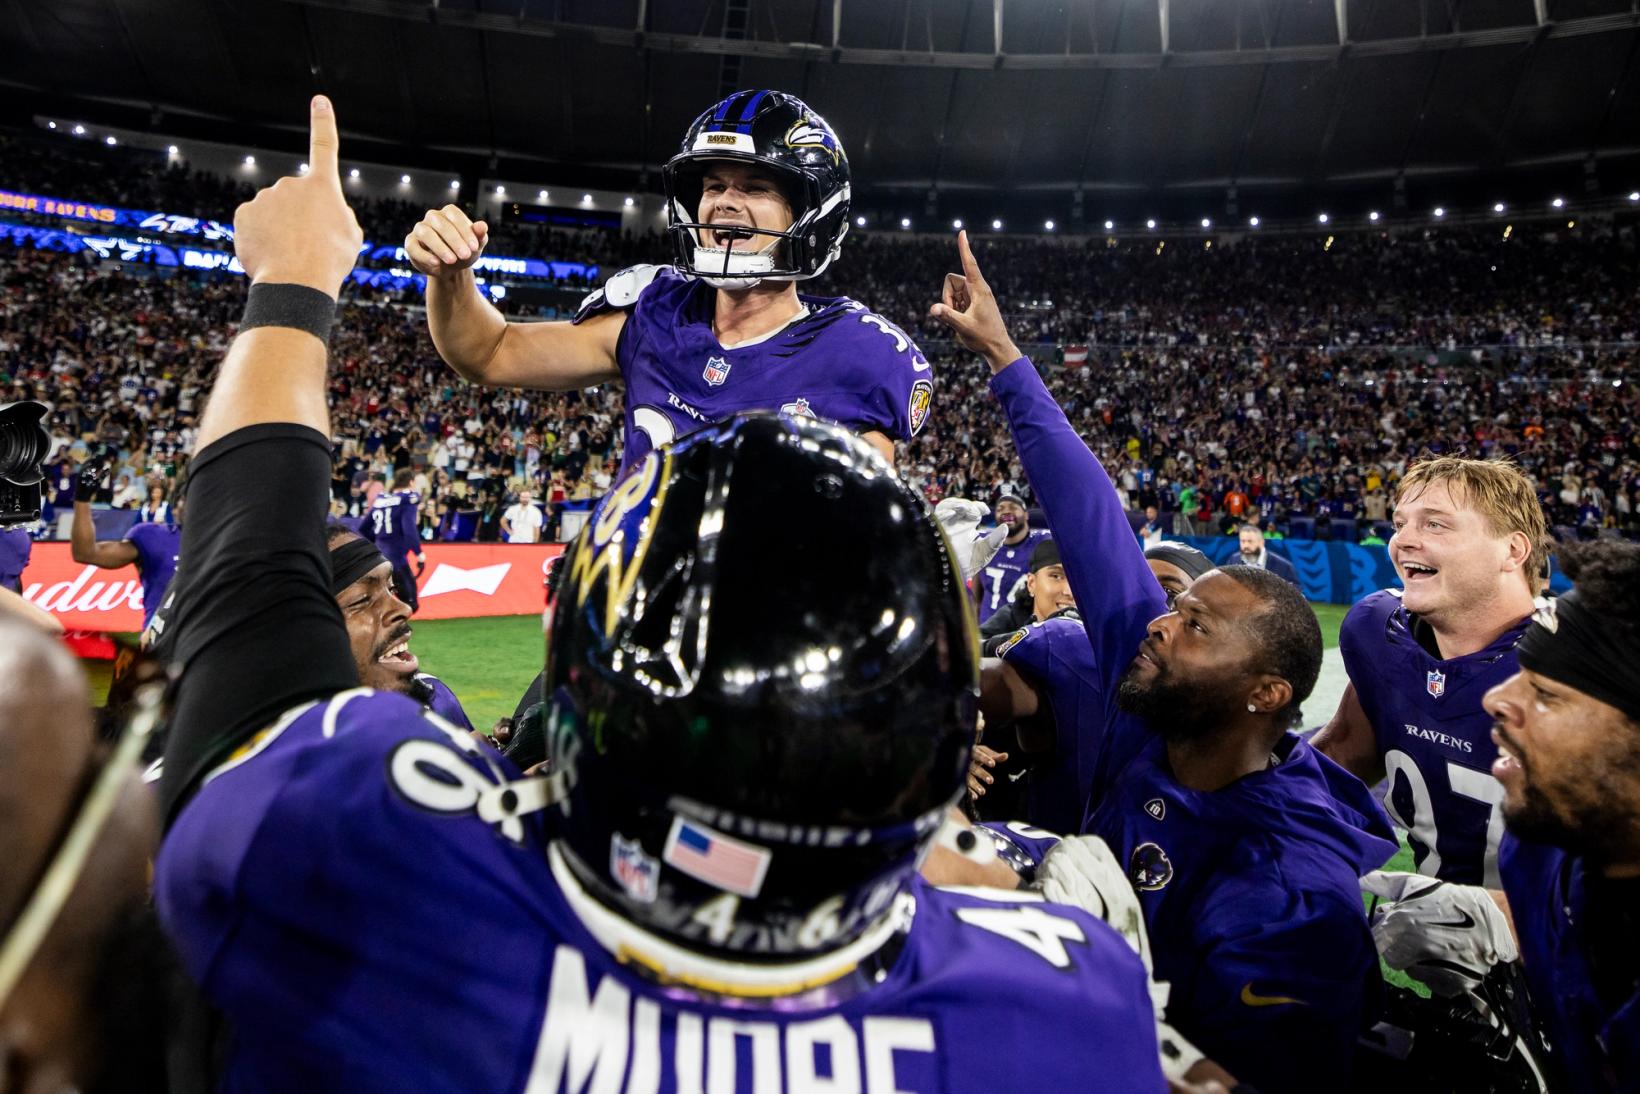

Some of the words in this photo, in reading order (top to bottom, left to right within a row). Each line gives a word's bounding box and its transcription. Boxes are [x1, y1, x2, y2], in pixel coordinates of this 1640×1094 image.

[707, 135, 737, 145] RAVENS
[45, 201, 116, 222] RAVENS
[706, 367, 724, 384] NFL
[667, 392, 716, 423] RAV
[1429, 681, 1443, 694] NFL
[1404, 724, 1472, 753] RAVENS
[956, 906, 1086, 968] 4
